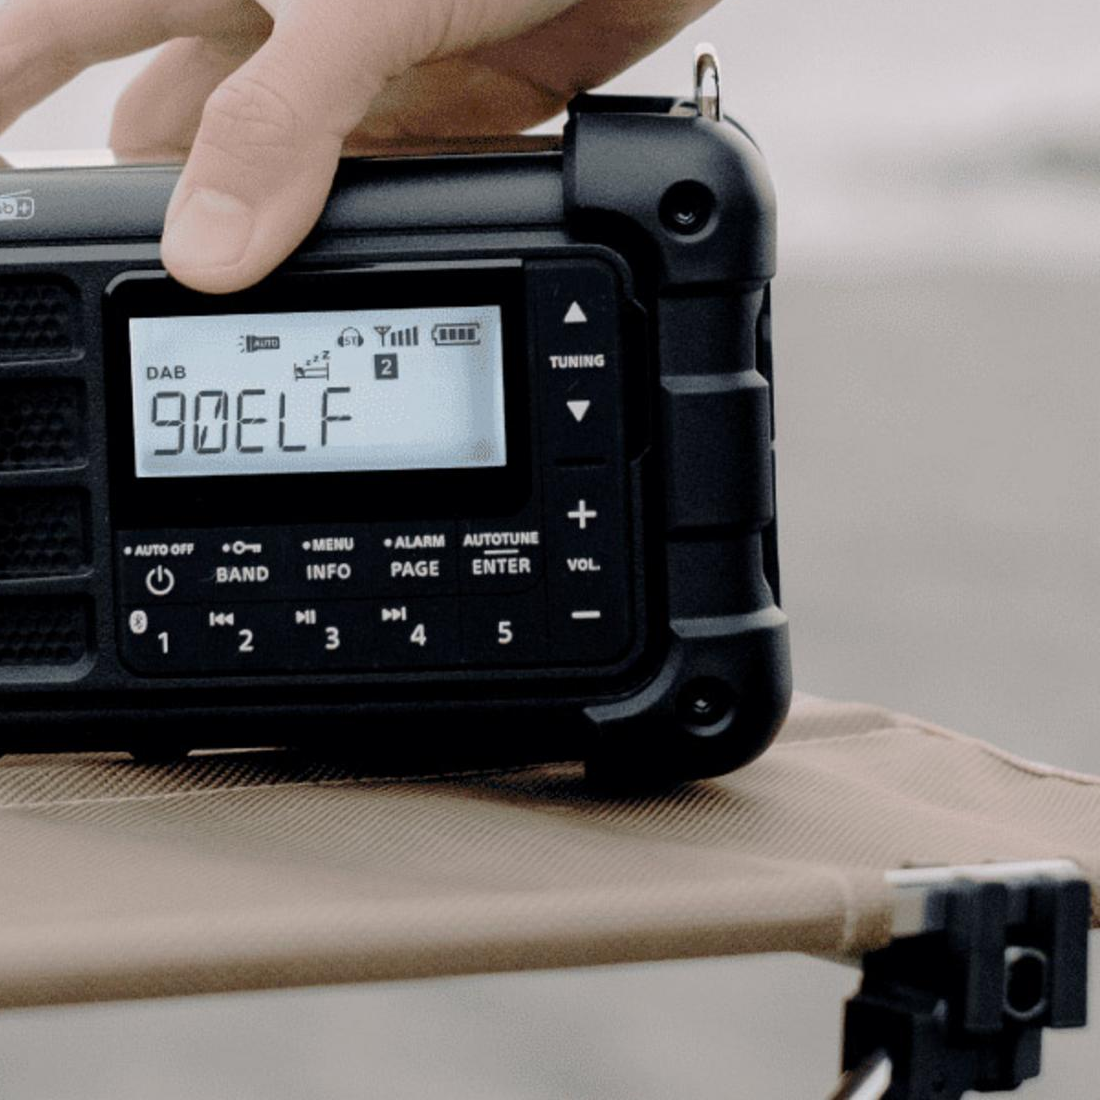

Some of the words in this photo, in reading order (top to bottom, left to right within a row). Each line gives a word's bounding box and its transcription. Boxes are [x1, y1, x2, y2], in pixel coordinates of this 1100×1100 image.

[380, 359, 393, 375] 2
[550, 355, 605, 369] TUNING
[146, 364, 187, 380] DAB
[151, 386, 353, 456] 90ELF
[312, 537, 355, 551] MENU
[394, 534, 446, 549] ALARM
[463, 531, 540, 546] AUTOTUNE
[134, 543, 168, 556] AUTO
[170, 543, 195, 555] OFF
[306, 563, 352, 580] INFO
[390, 560, 440, 577] PAGE
[472, 557, 532, 575] ENTER
[566, 557, 601, 572] VOL.
[216, 566, 270, 583] BAND
[238, 628, 254, 652] 2
[324, 626, 341, 650] 3
[410, 623, 427, 647] 4
[497, 620, 514, 644] 5
[157, 631, 169, 654] 1
